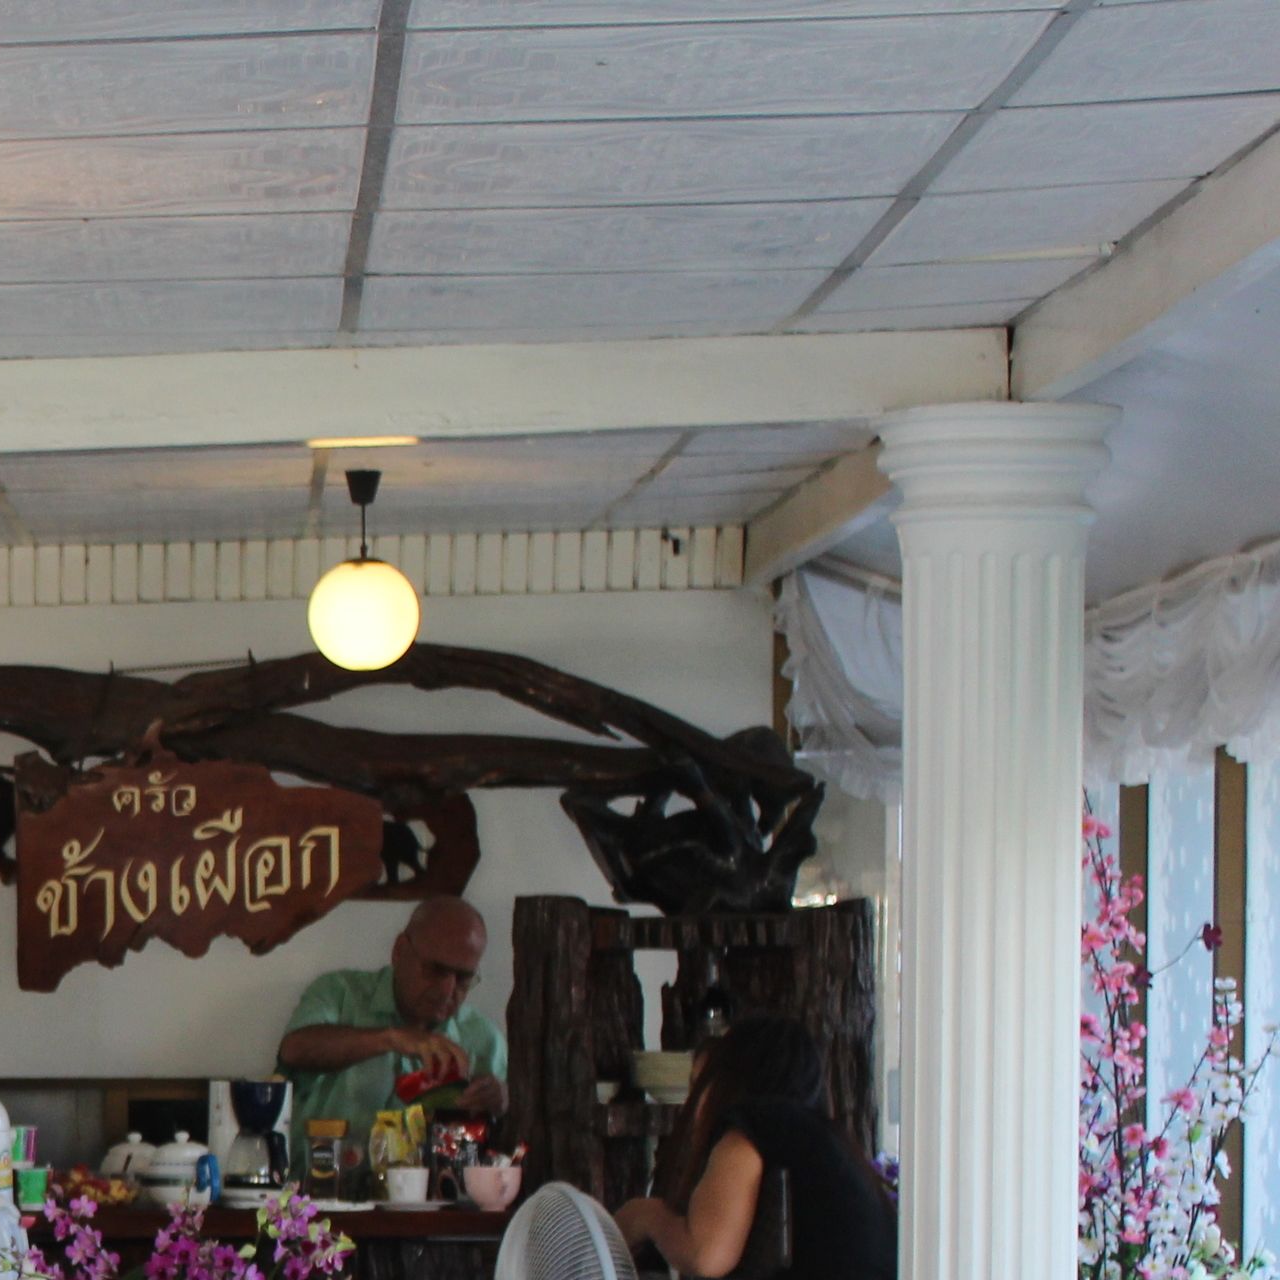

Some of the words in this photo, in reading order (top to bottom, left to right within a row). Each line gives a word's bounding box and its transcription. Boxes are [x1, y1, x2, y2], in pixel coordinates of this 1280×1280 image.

[112, 770, 197, 818] ครัว
[36, 807, 340, 941] ช้างเผือก
